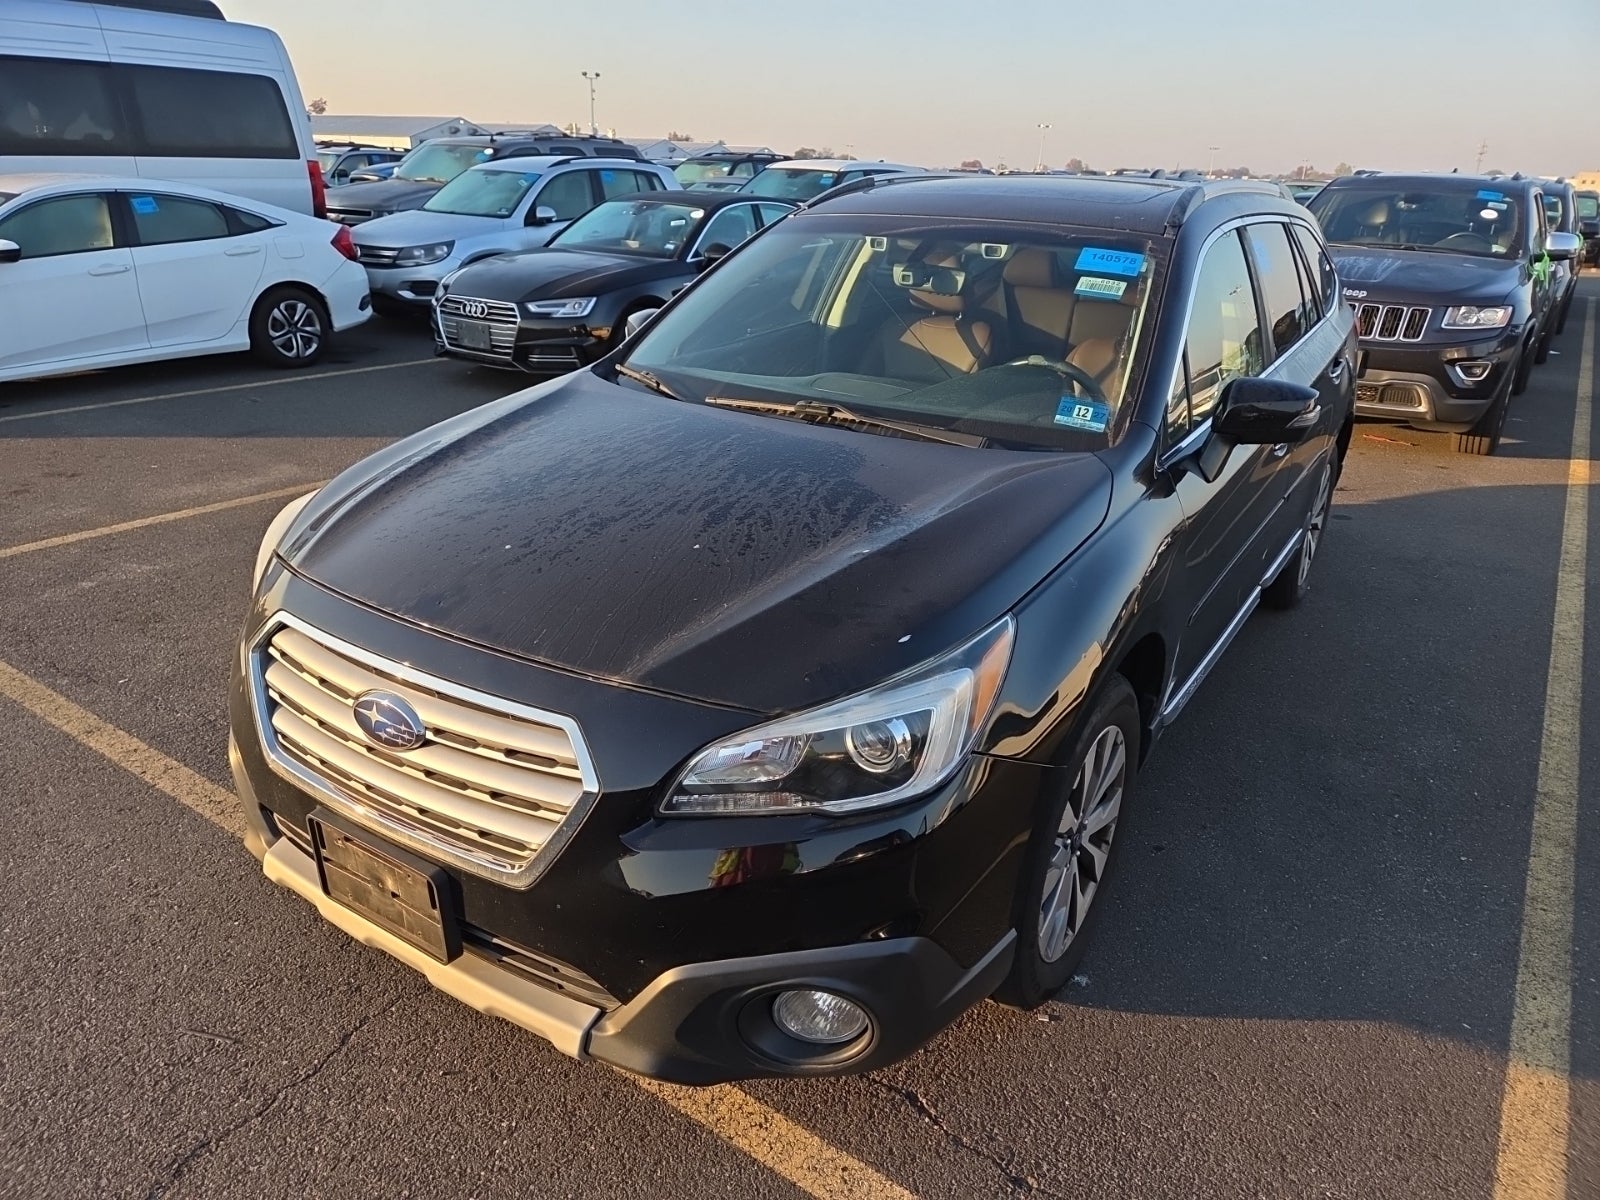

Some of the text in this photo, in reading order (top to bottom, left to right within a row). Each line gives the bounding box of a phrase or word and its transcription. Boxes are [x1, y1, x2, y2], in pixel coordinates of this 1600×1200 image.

[1090, 253, 1138, 265] 140578
[1061, 405, 1106, 419] 20 12 27
